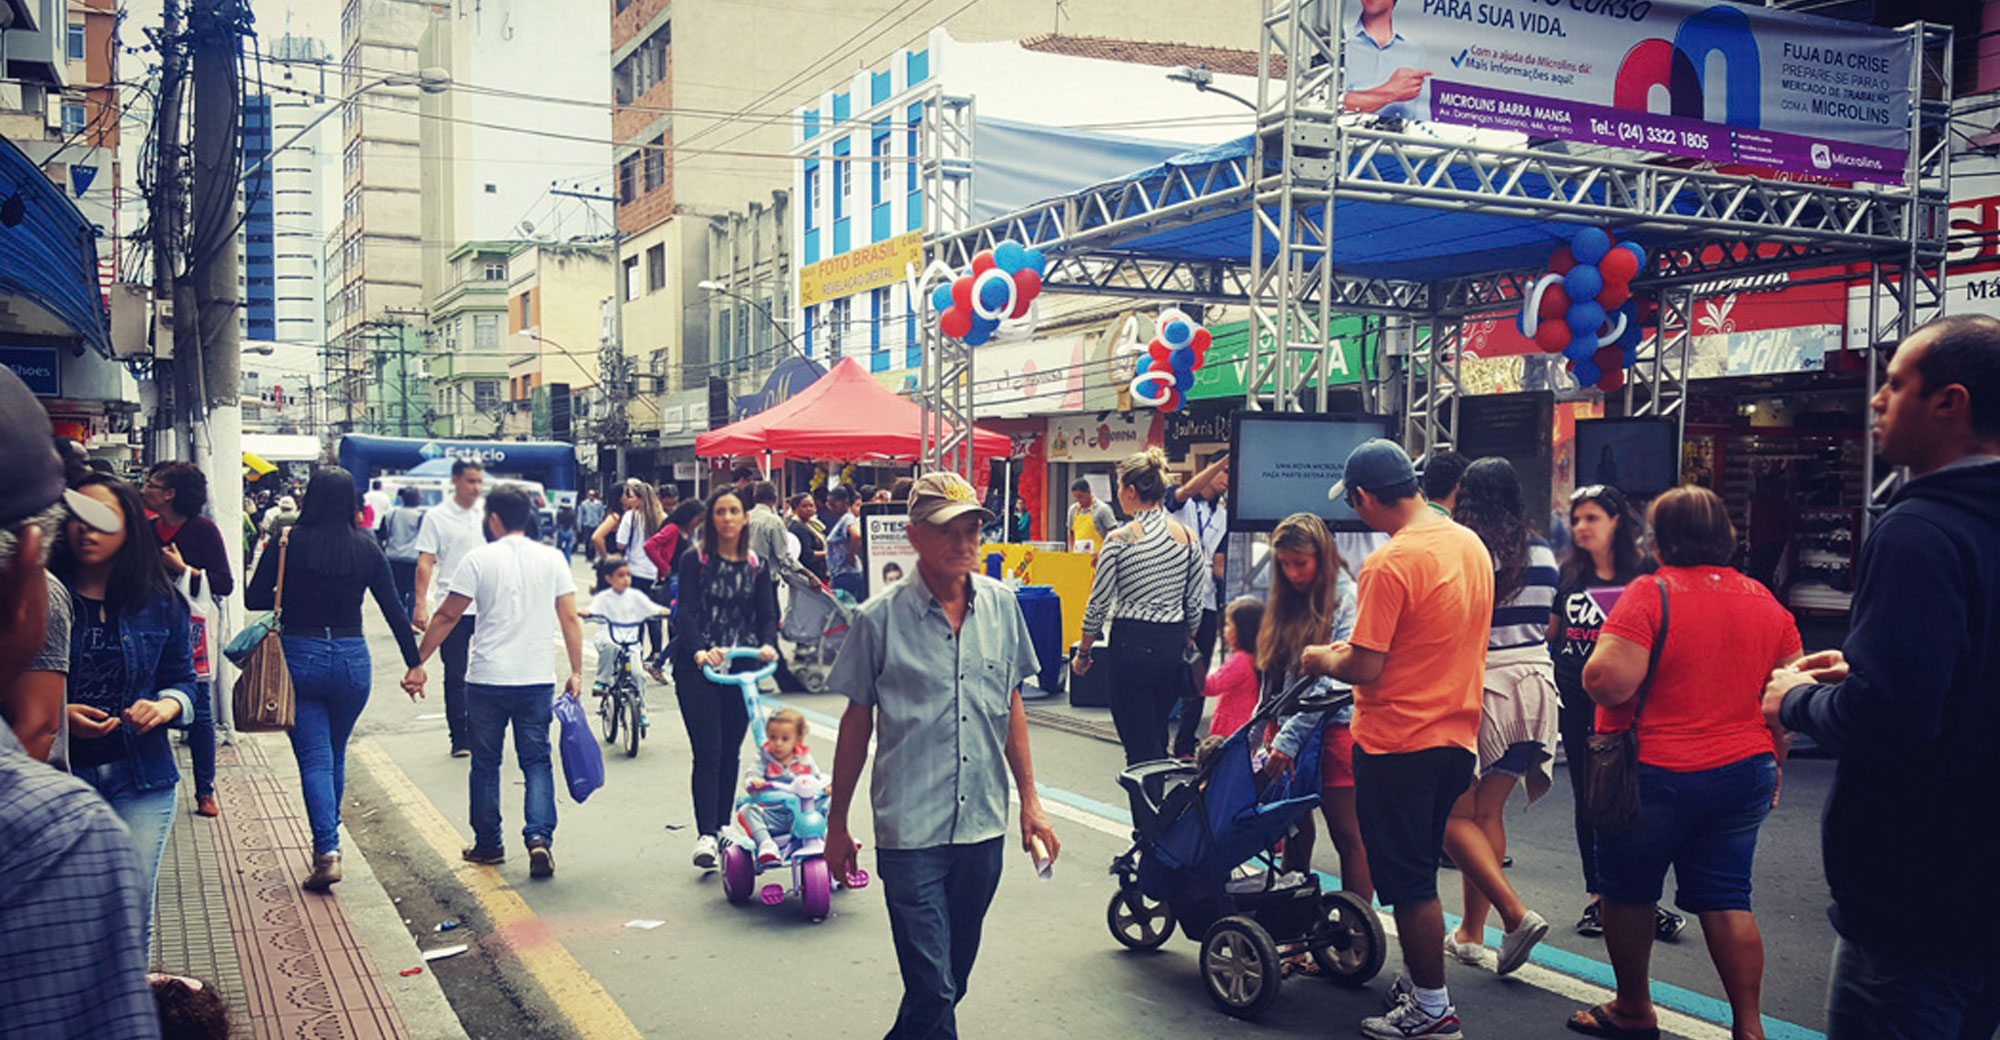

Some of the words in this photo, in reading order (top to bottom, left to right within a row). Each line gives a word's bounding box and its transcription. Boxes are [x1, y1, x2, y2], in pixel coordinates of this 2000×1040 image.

[1423, 0, 1472, 21] PARA
[1477, 4, 1515, 29] SUA
[1520, 11, 1567, 38] VIDA.
[1464, 57, 1488, 71] Mais
[1490, 61, 1549, 82] informações
[1470, 44, 1491, 58] Com
[1492, 49, 1498, 59] a
[1499, 49, 1524, 63] ajuda
[1525, 54, 1536, 65] da
[1537, 55, 1577, 73] Microlins
[1783, 42, 1820, 63] FUJA
[1824, 49, 1843, 67] DA
[1847, 53, 1889, 74] CRISE
[1782, 63, 1848, 86] PREPARE-SE
[1850, 74, 1879, 89] PARA
[1880, 80, 1890, 92] O
[1782, 79, 1827, 95] MERCADO
[1828, 86, 1840, 98] DE
[1843, 88, 1890, 105] TRABALHO
[1439, 91, 1496, 113] MICROLINS
[1498, 100, 1532, 118] BARRA
[1533, 107, 1573, 124] MANSA
[1454, 109, 1494, 123] Domingos
[1811, 98, 1890, 125] MICROLINS
[1589, 118, 1615, 137] Tel.:
[1618, 122, 1644, 144] (24)
[1646, 127, 1676, 145] 3322
[1680, 131, 1709, 150] 1805
[1831, 152, 1884, 171] Microlins
[818, 254, 850, 278] FOTO
[852, 240, 899, 268] BRASIL
[1565, 592, 1601, 626] Eu
